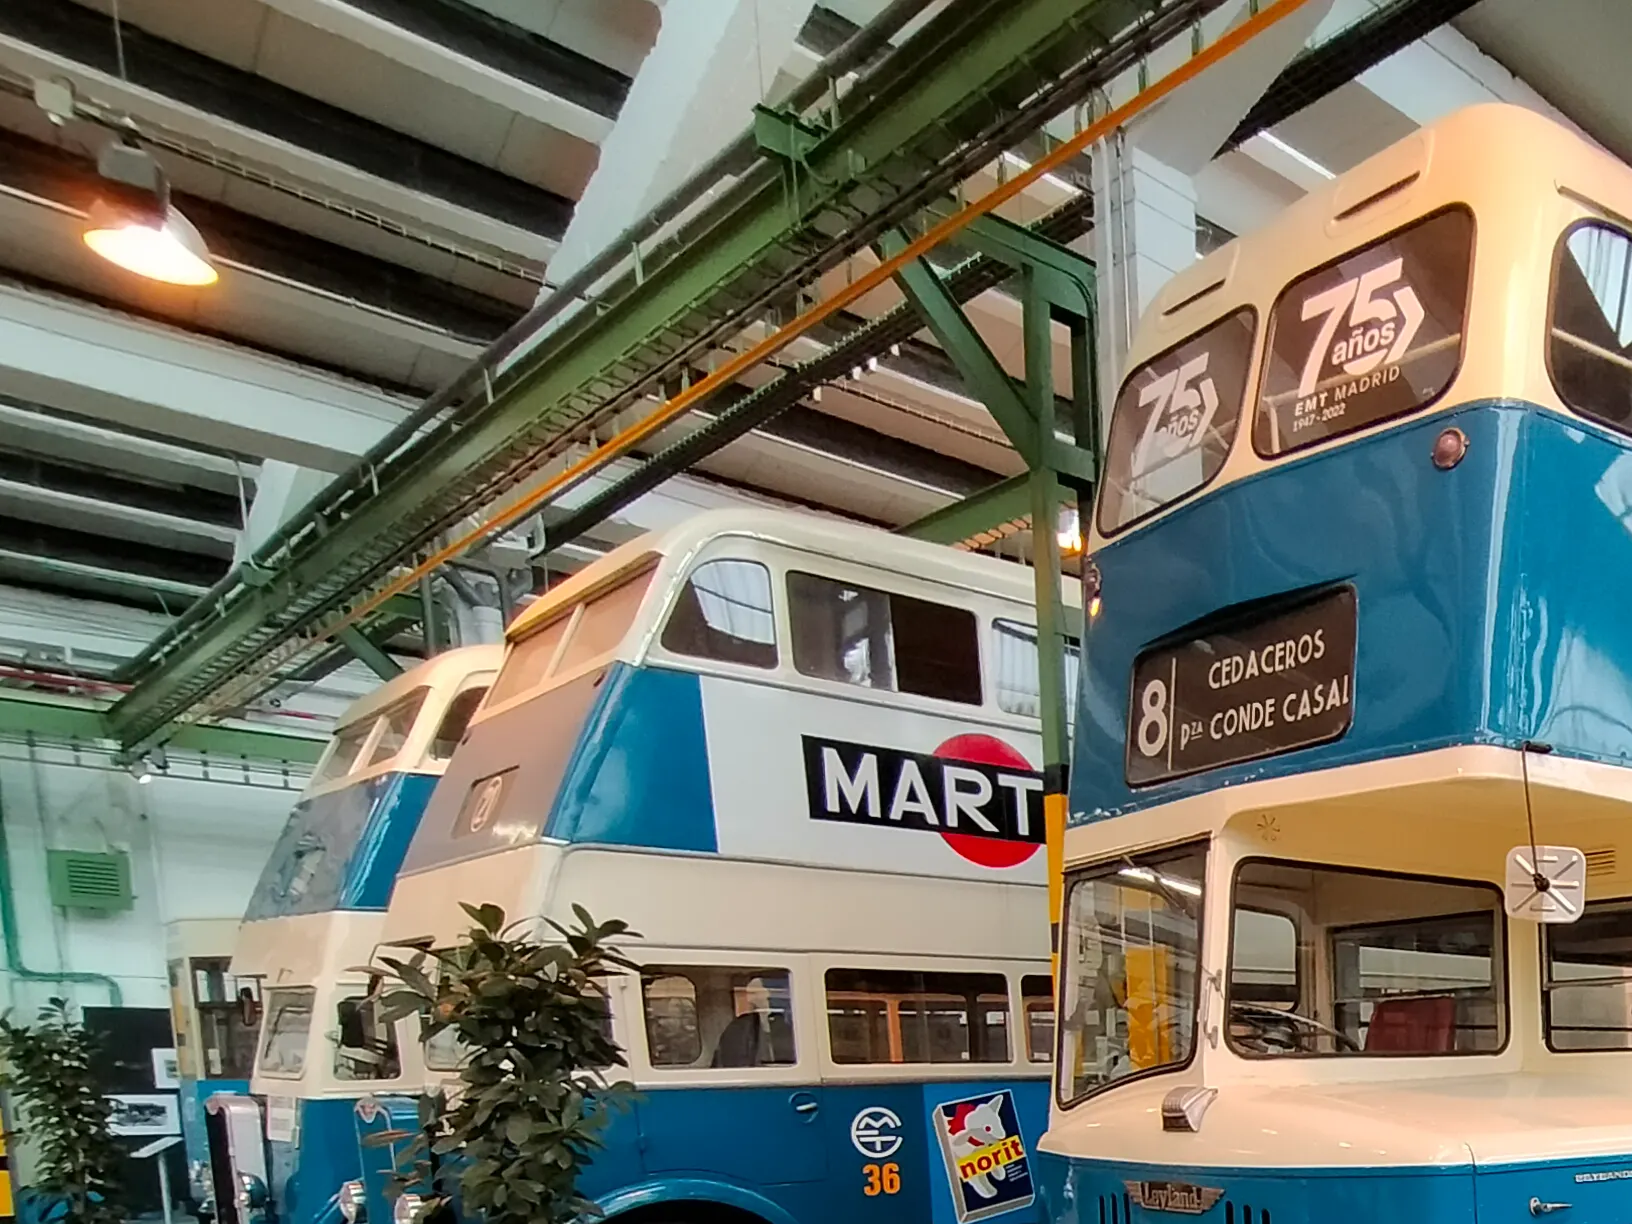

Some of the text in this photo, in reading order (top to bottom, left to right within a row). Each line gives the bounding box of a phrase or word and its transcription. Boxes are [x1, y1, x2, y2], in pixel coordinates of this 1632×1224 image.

[1298, 257, 1403, 398] 75
[1332, 322, 1395, 366] años
[1131, 351, 1210, 478] 75
[1295, 366, 1400, 417] EMT MADRID
[1208, 628, 1326, 690] CEDACEROS
[1138, 679, 1168, 757] 8
[1209, 698, 1276, 740] CONDE
[1282, 675, 1350, 733] CASAL
[821, 746, 1044, 836] MART
[863, 1162, 901, 1196] 36
[960, 1139, 1024, 1179] norit
